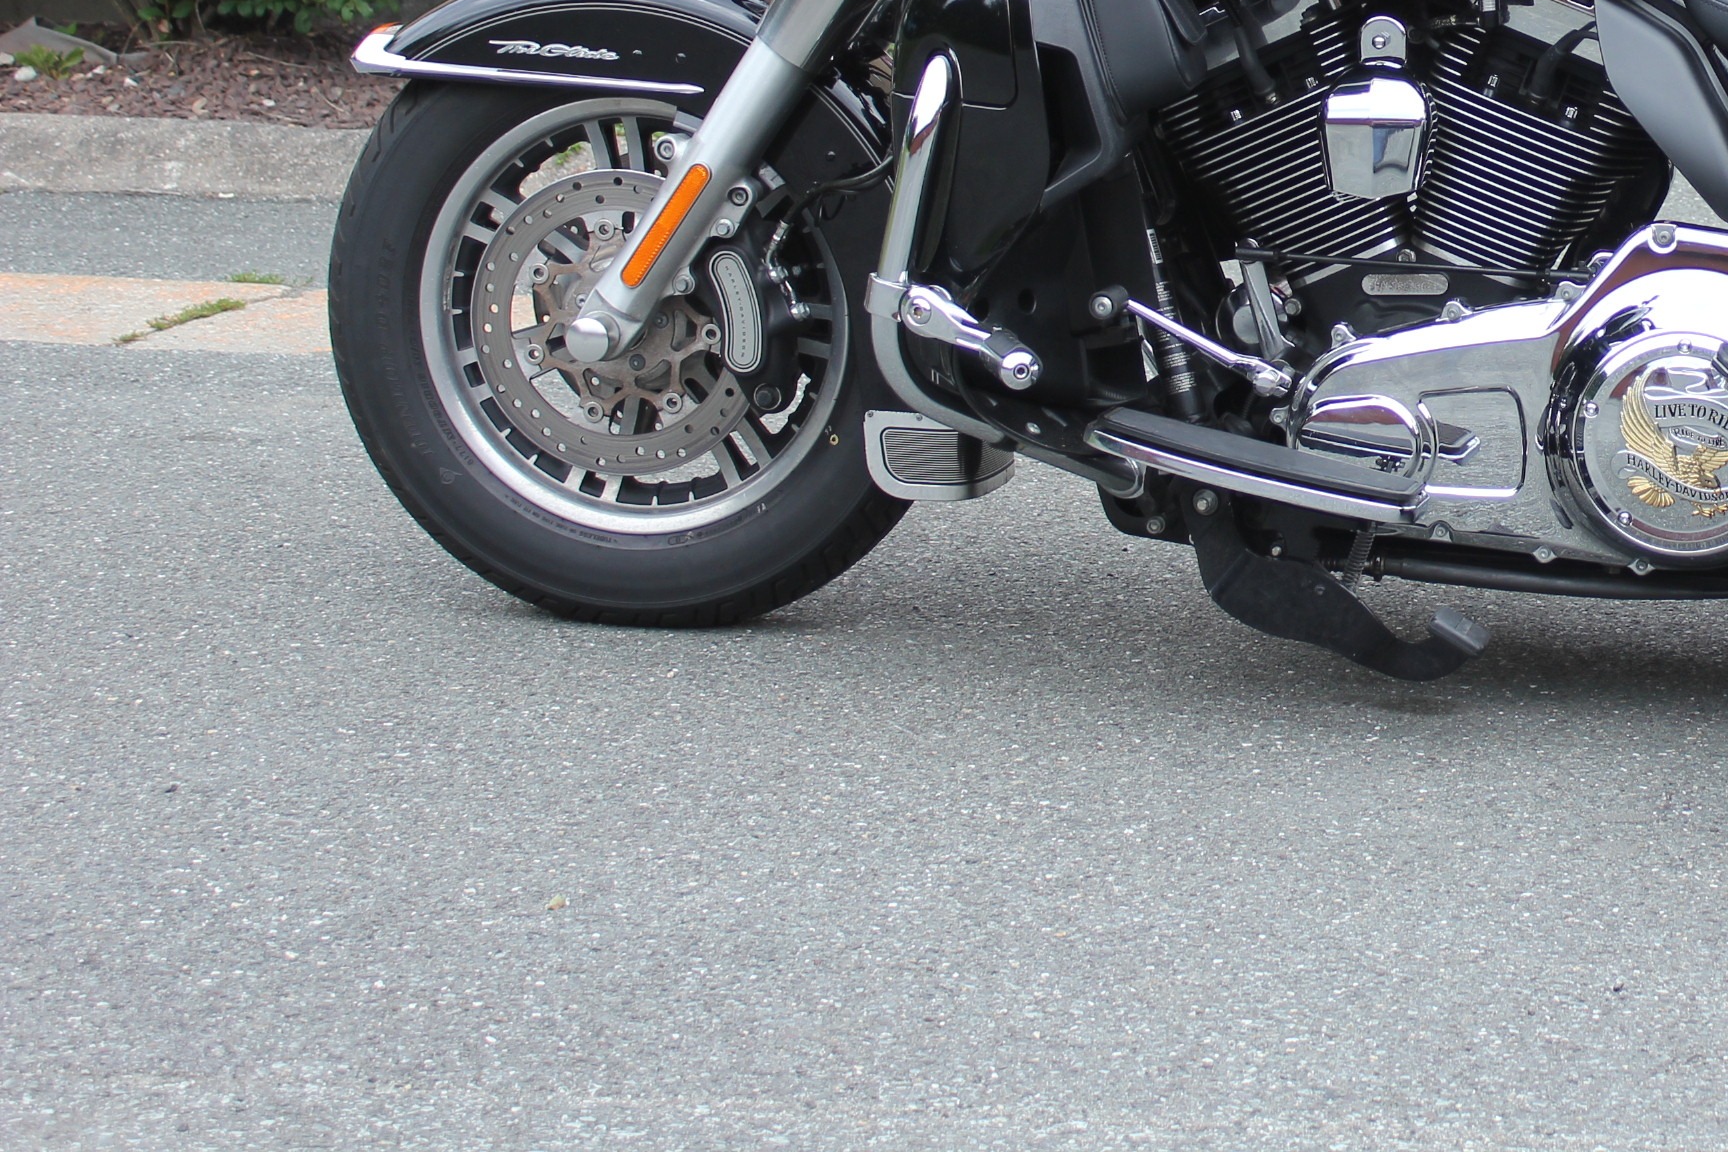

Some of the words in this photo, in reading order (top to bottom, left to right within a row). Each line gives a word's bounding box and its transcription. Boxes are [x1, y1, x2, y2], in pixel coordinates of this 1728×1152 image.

[724, 265, 747, 359] HARLEY-DAVIDSON
[1654, 403, 1687, 419] LIVE
[1688, 403, 1707, 419] TO
[1673, 427, 1694, 438] RIDE
